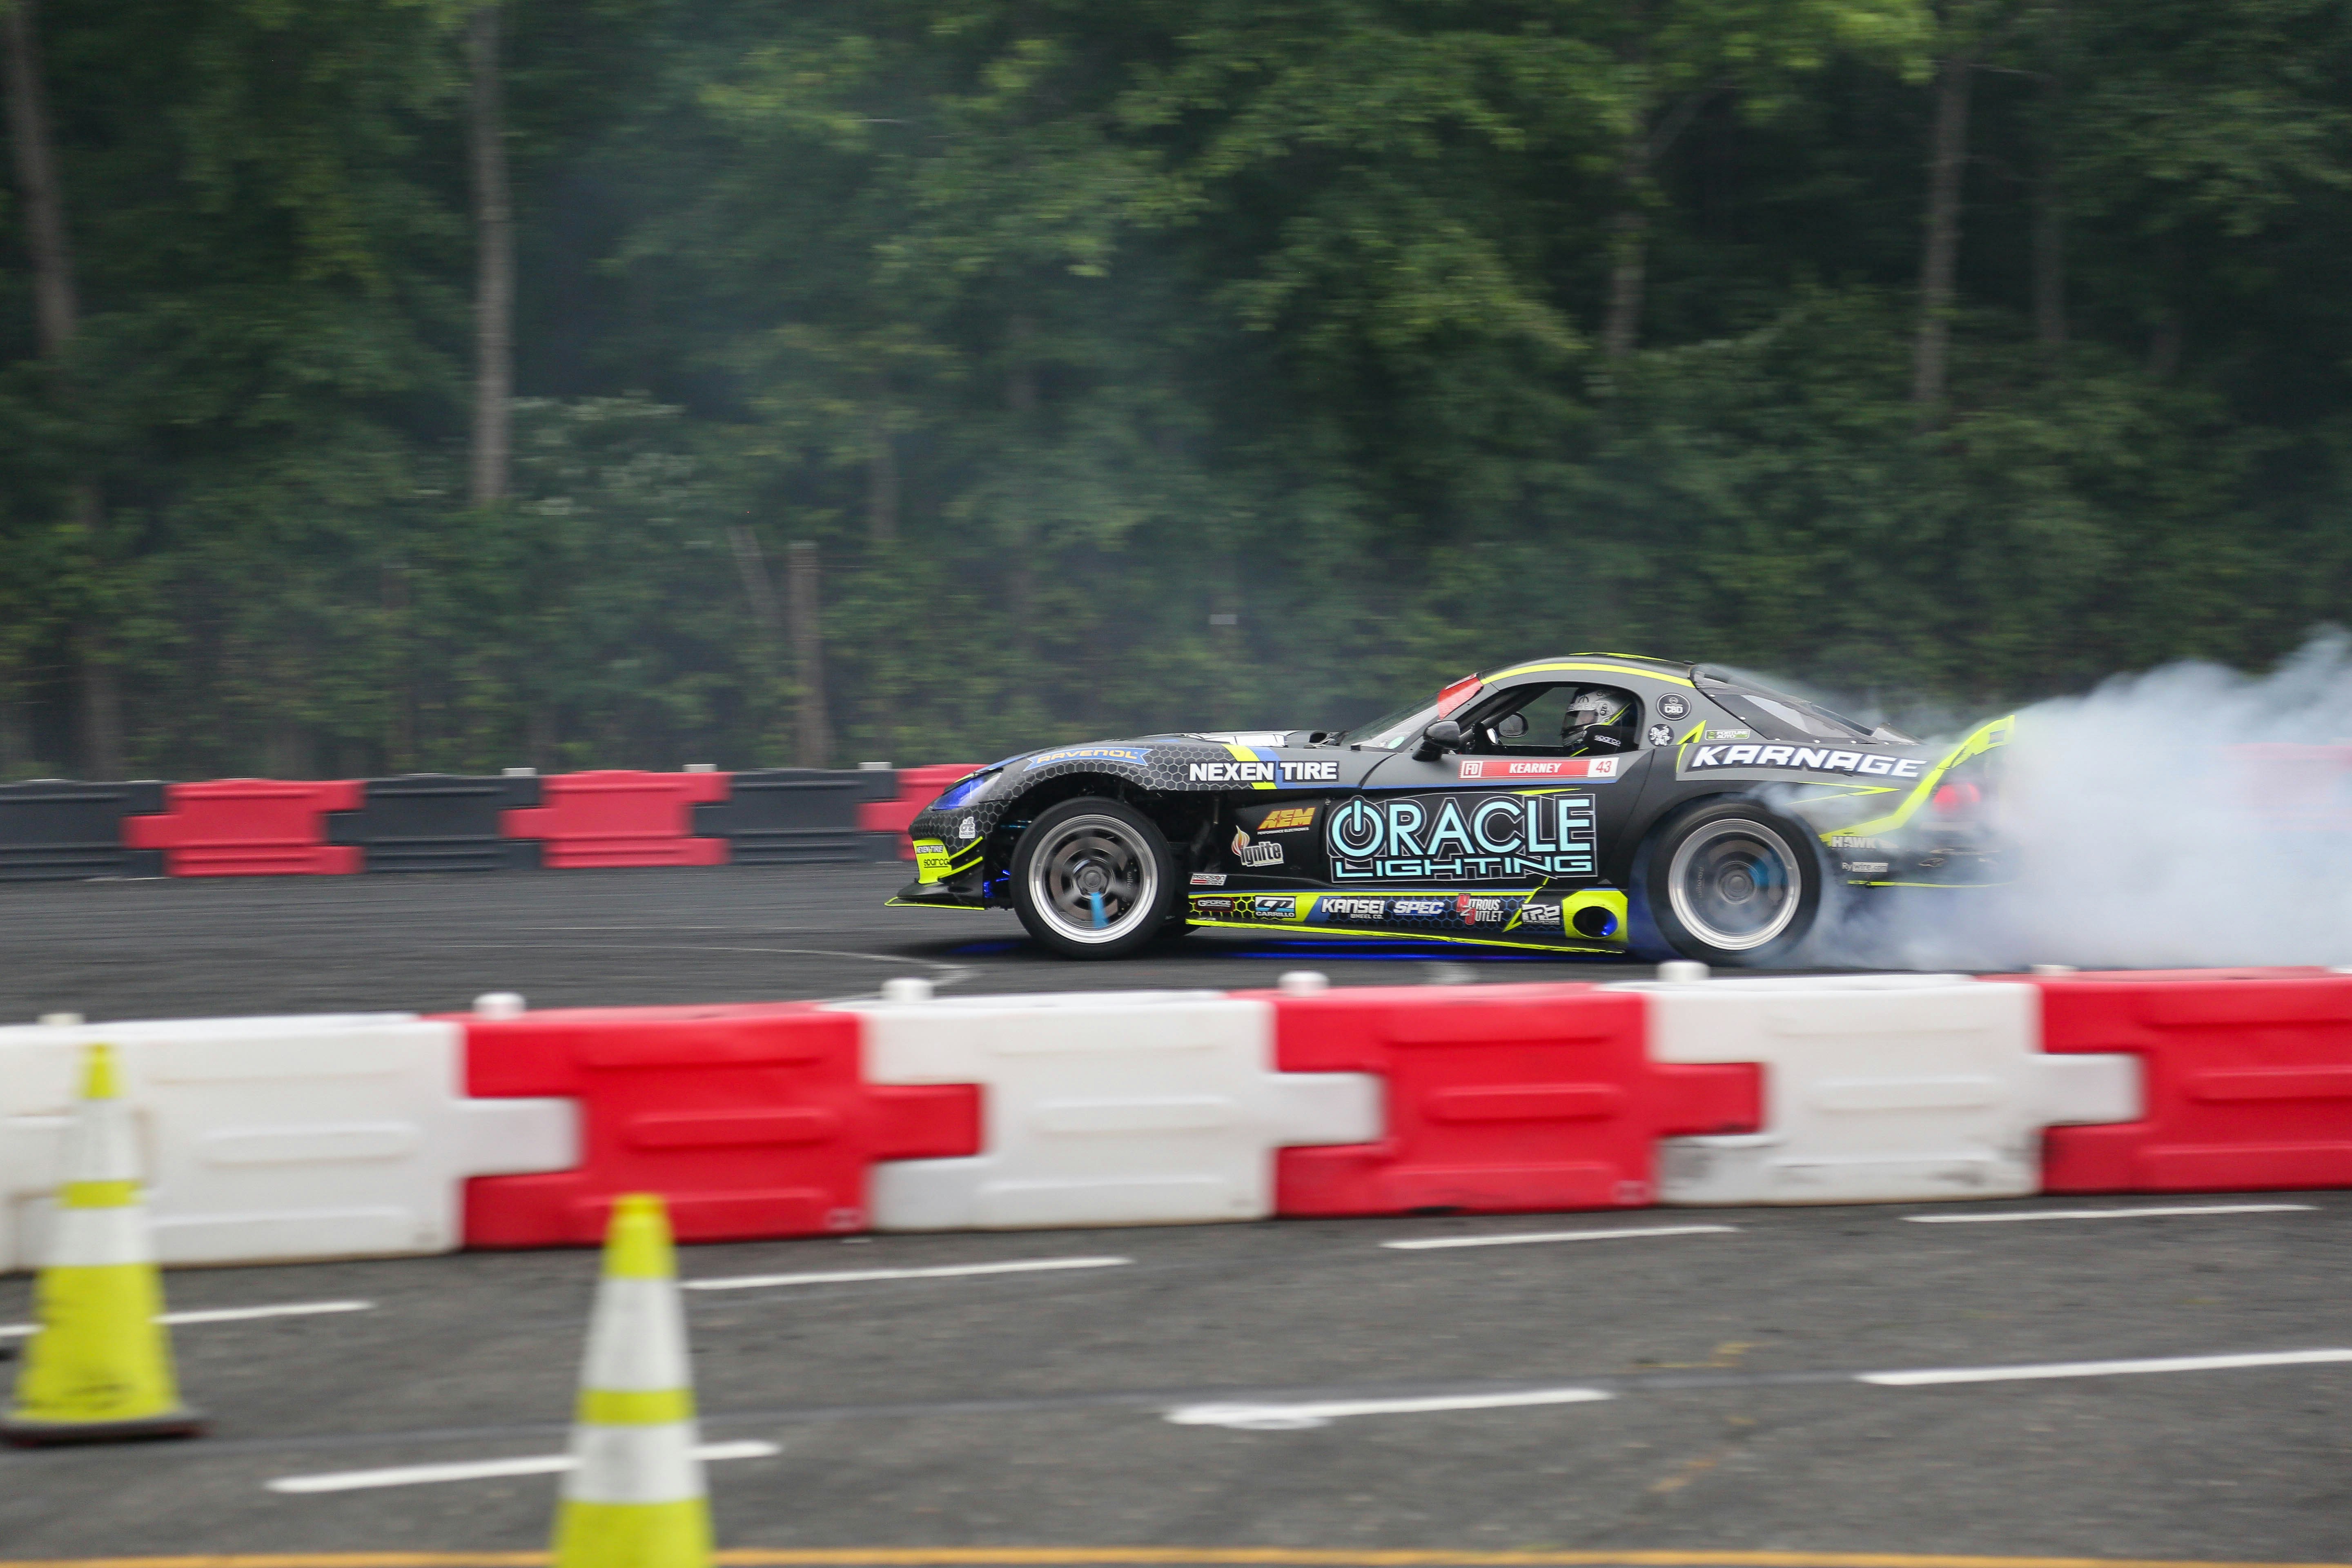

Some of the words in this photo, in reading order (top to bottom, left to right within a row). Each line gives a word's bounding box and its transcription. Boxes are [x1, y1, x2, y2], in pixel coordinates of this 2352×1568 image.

[1595, 735, 1621, 746] sparco
[1036, 750, 1138, 764] RAVENOL
[1691, 744, 1927, 777] KARNAGE
[1189, 763, 1274, 781] NEXEN
[1280, 762, 1338, 780] TIRE
[1509, 763, 1562, 774] KEARNEY
[1596, 761, 1611, 773] 43
[1257, 807, 1316, 830] AEM
[1332, 799, 1591, 857] ORACLE
[1336, 856, 1592, 878] LIGHTING
[1321, 898, 1385, 914] KANSEI
[1393, 901, 1445, 915] SPEC
